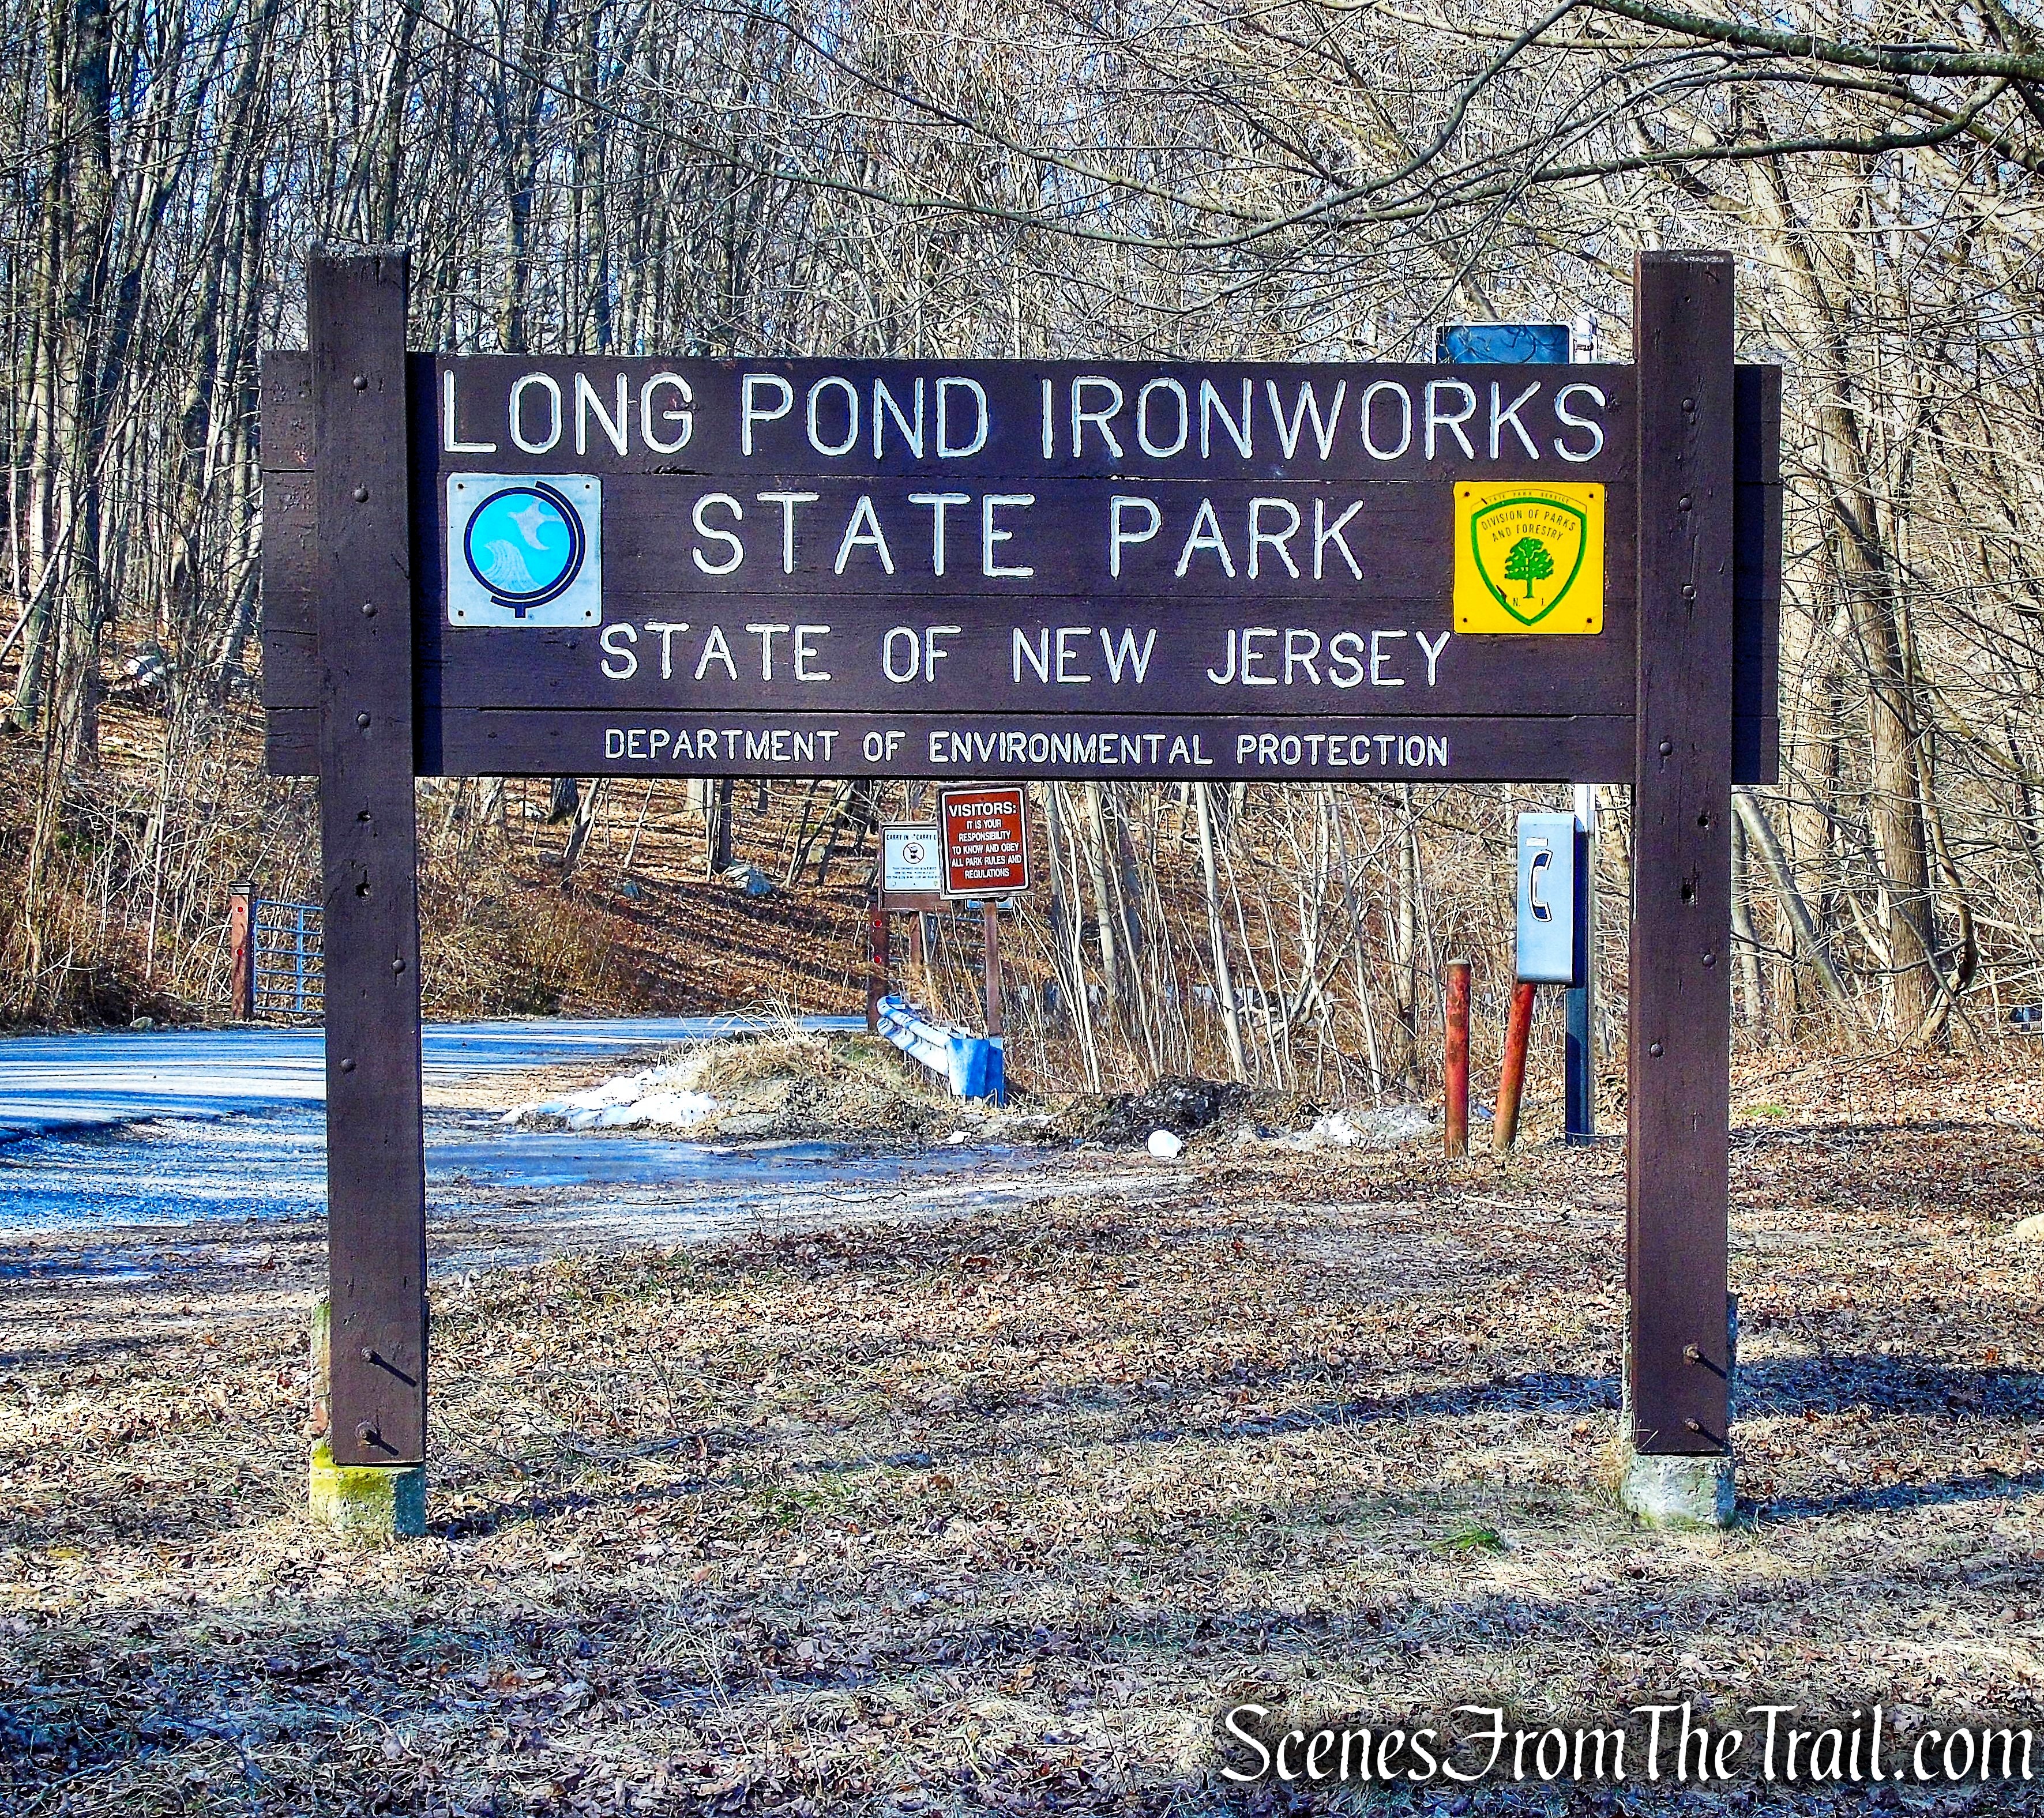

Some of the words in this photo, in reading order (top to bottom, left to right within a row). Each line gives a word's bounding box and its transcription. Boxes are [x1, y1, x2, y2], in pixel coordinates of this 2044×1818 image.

[443, 369, 694, 457] LONG
[741, 373, 990, 460] POND
[1040, 375, 1607, 463] IRONWORKS
[1481, 510, 1522, 530] DIVISION
[1528, 509, 1539, 519] OF
[1544, 511, 1576, 531] PARKS
[692, 491, 1036, 578] STATE
[1109, 495, 1365, 582] PARK
[1492, 527, 1512, 542] AND
[1516, 524, 1564, 541] FORESTRY
[599, 622, 832, 683] STATE
[882, 624, 963, 684] OF
[1012, 626, 1158, 685] NEW
[1206, 627, 1452, 689] JERSEY
[604, 728, 836, 763] DEPARTMENT
[862, 730, 907, 763] OF
[929, 731, 1213, 766] ENVIRONMENTAL
[1236, 732, 1448, 767] PROTECTION
[948, 801, 1016, 817] VISITORS:
[966, 820, 973, 829] IT
[975, 819, 982, 829] IS
[983, 819, 1002, 829] YOUR
[959, 830, 1011, 842] RESPONSIBILITY
[952, 846, 961, 855] TO
[963, 844, 983, 854] KNOW
[985, 843, 1000, 853] AND
[1001, 842, 1019, 852] OBEY
[952, 858, 964, 867] ALL
[965, 857, 983, 866] PARK
[984, 855, 1006, 865] RULES
[1008, 854, 1022, 864] AND
[964, 867, 1010, 879] REGULATIONS
